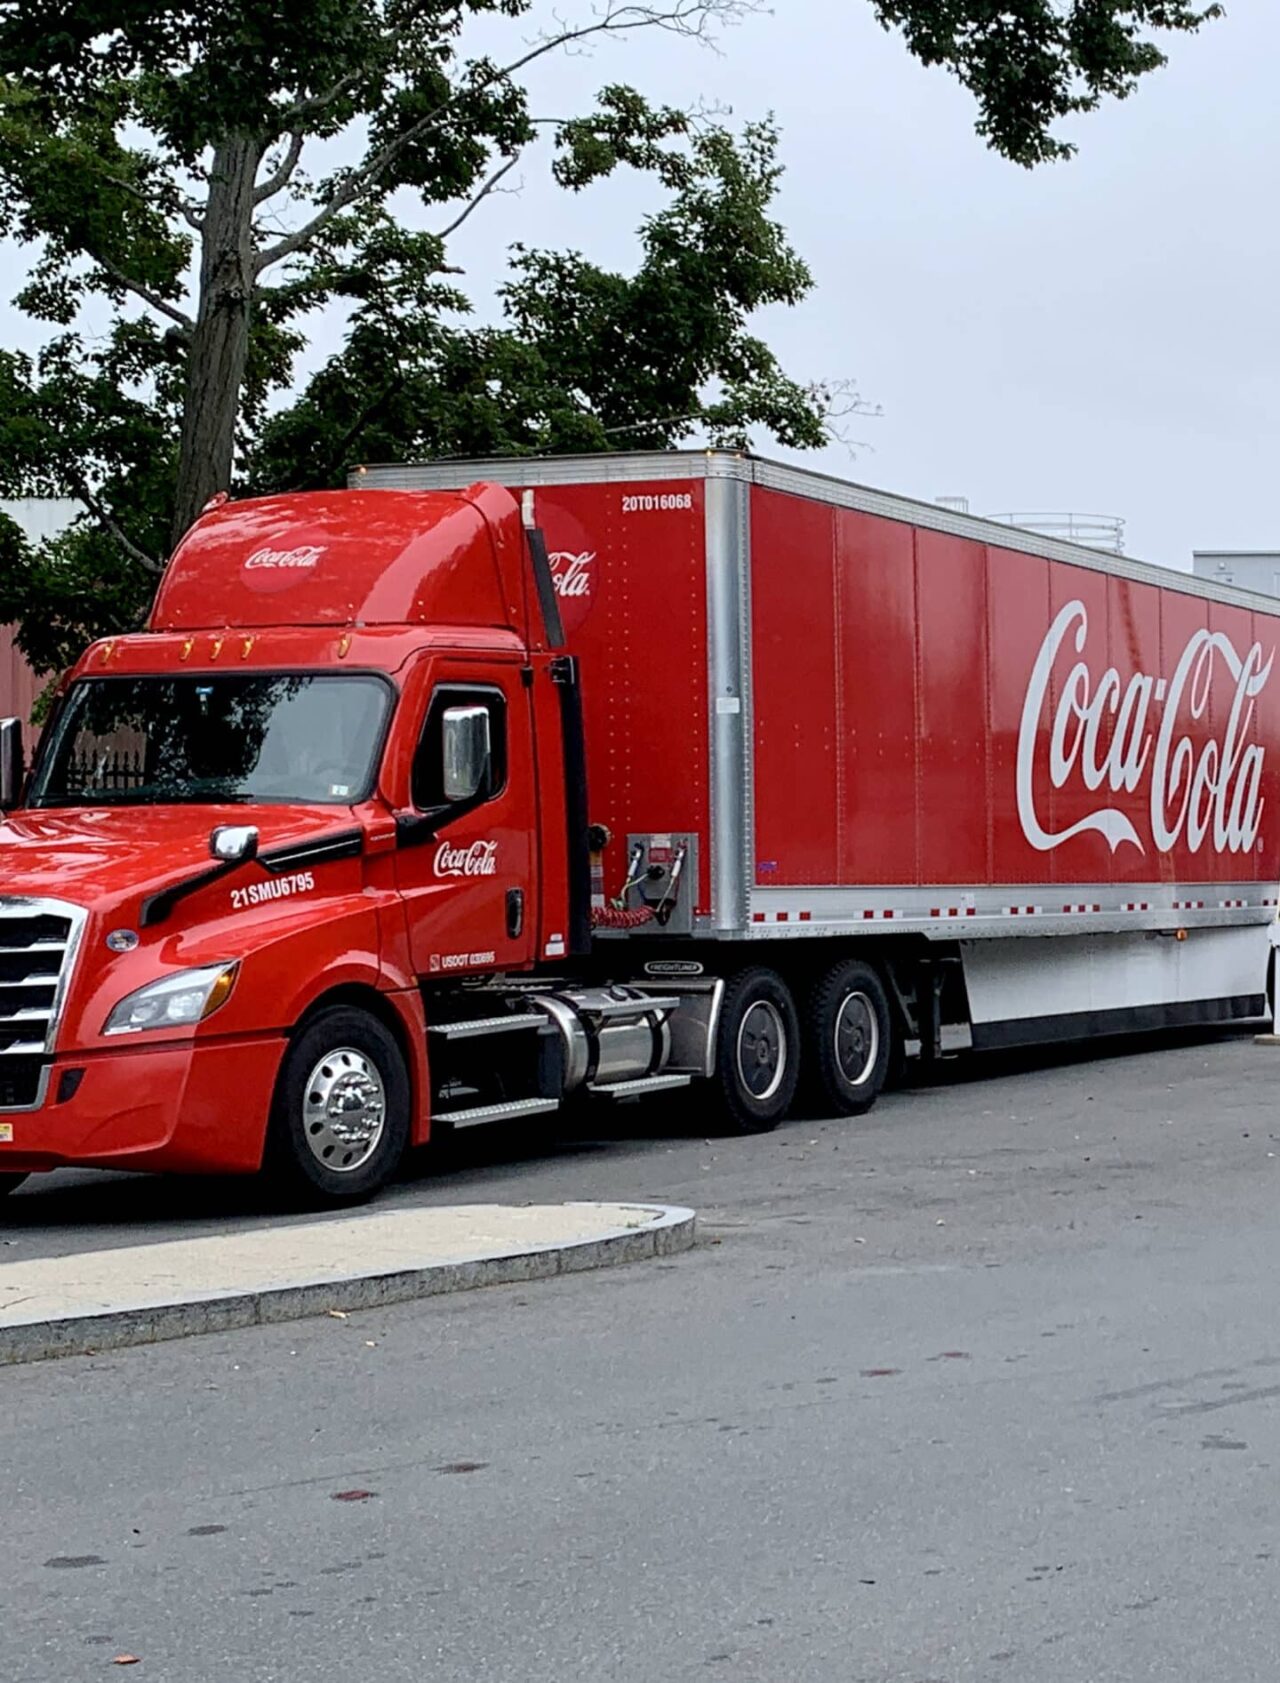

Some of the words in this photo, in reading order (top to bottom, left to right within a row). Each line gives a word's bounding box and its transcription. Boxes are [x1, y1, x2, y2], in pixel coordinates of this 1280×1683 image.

[622, 494, 692, 511] 20T016068
[245, 545, 329, 569] Coca-Cola
[1016, 599, 1276, 856] Coca-Cola
[433, 839, 498, 878] Coca-Cola
[230, 871, 315, 909] 21SMU6795
[441, 953, 469, 968] USDOT
